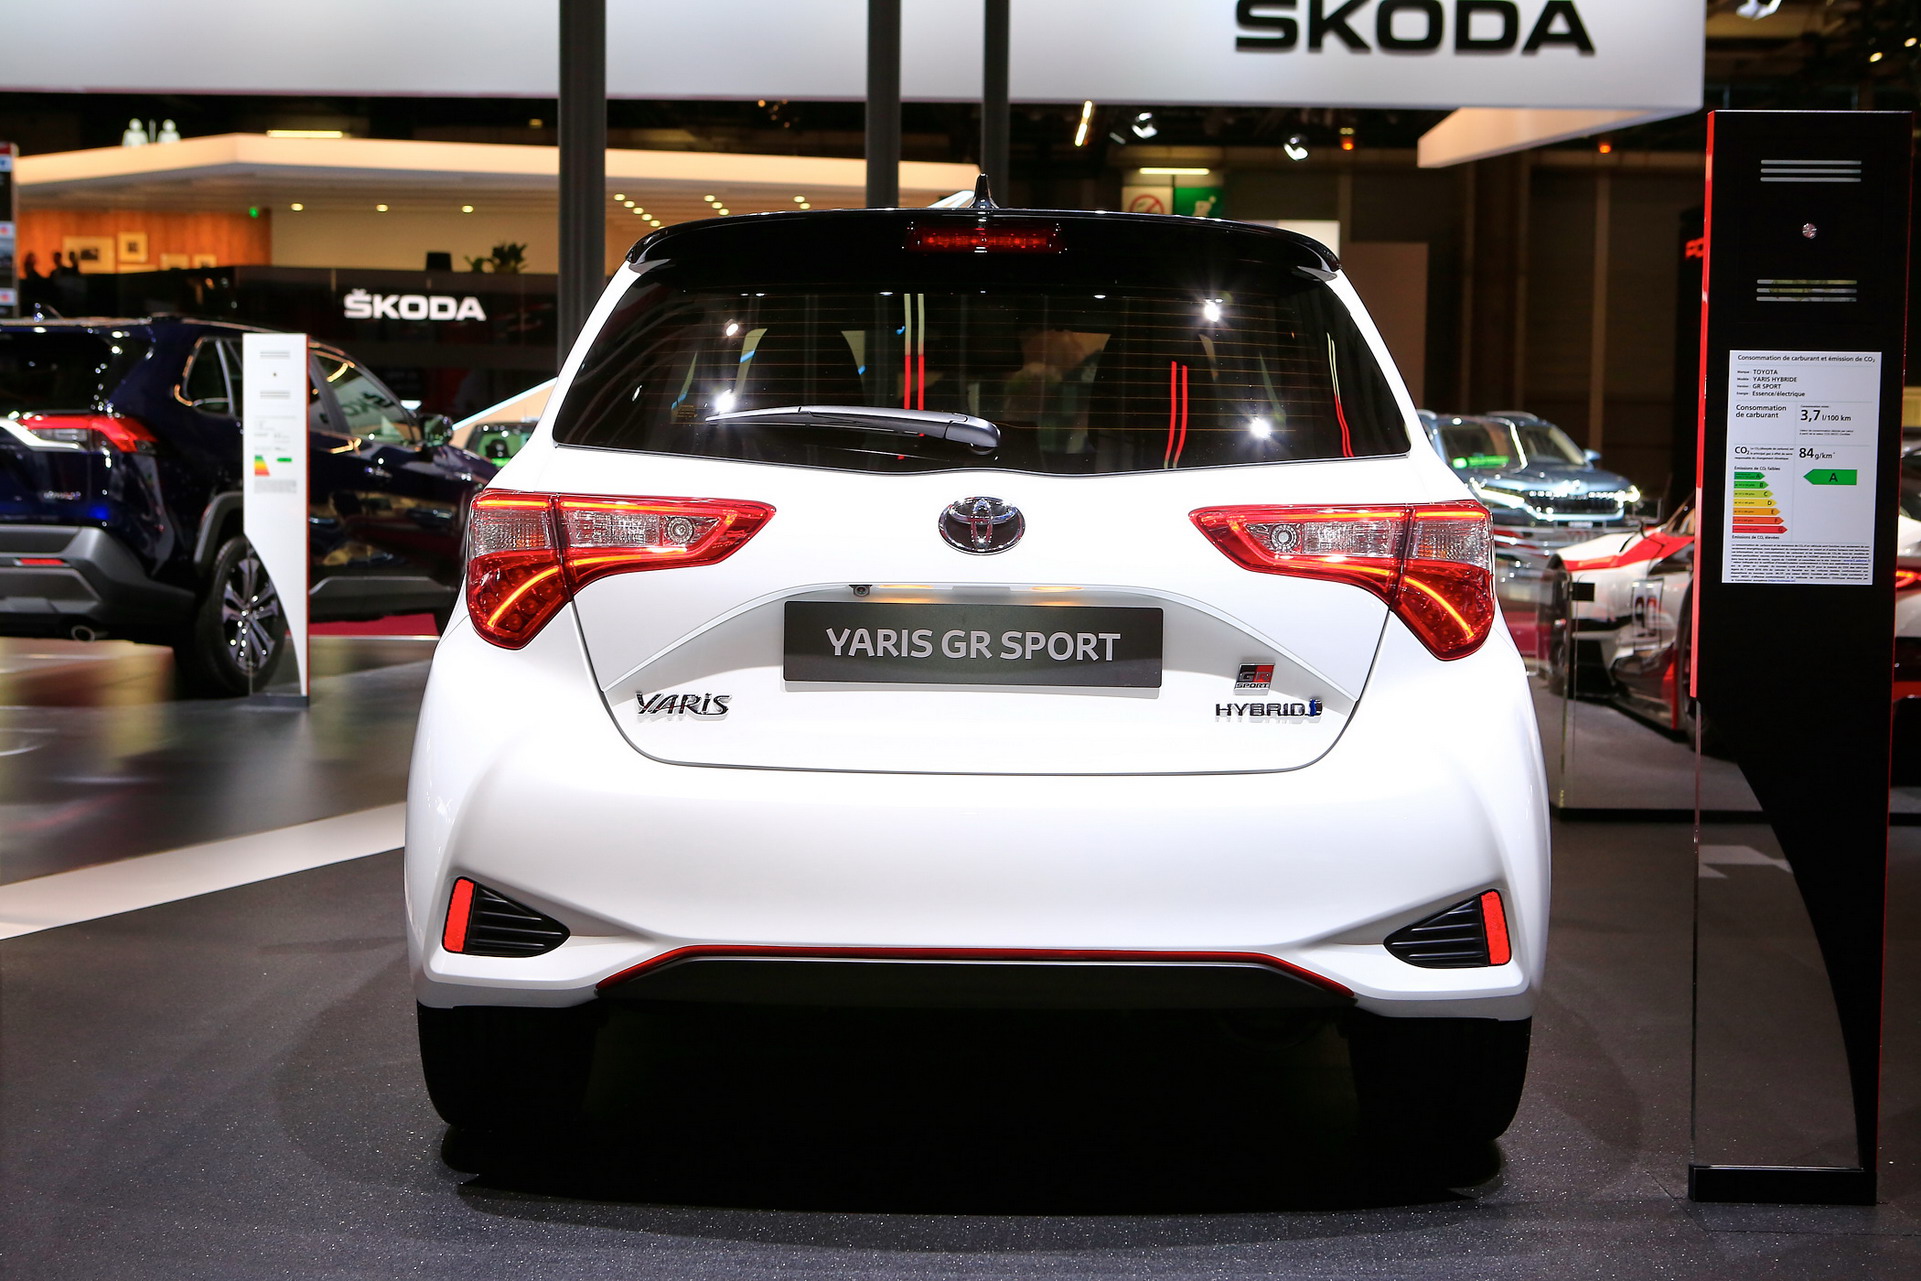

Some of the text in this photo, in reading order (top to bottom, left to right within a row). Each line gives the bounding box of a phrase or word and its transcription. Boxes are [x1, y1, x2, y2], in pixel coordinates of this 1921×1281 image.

[343, 288, 487, 321] ŠKODA
[1800, 409, 1821, 422] 3,7
[1799, 447, 1814, 459] 84
[1828, 472, 1838, 482] A
[826, 628, 1121, 662] YARIS GR SPORT
[1215, 702, 1306, 717] HYBRID
